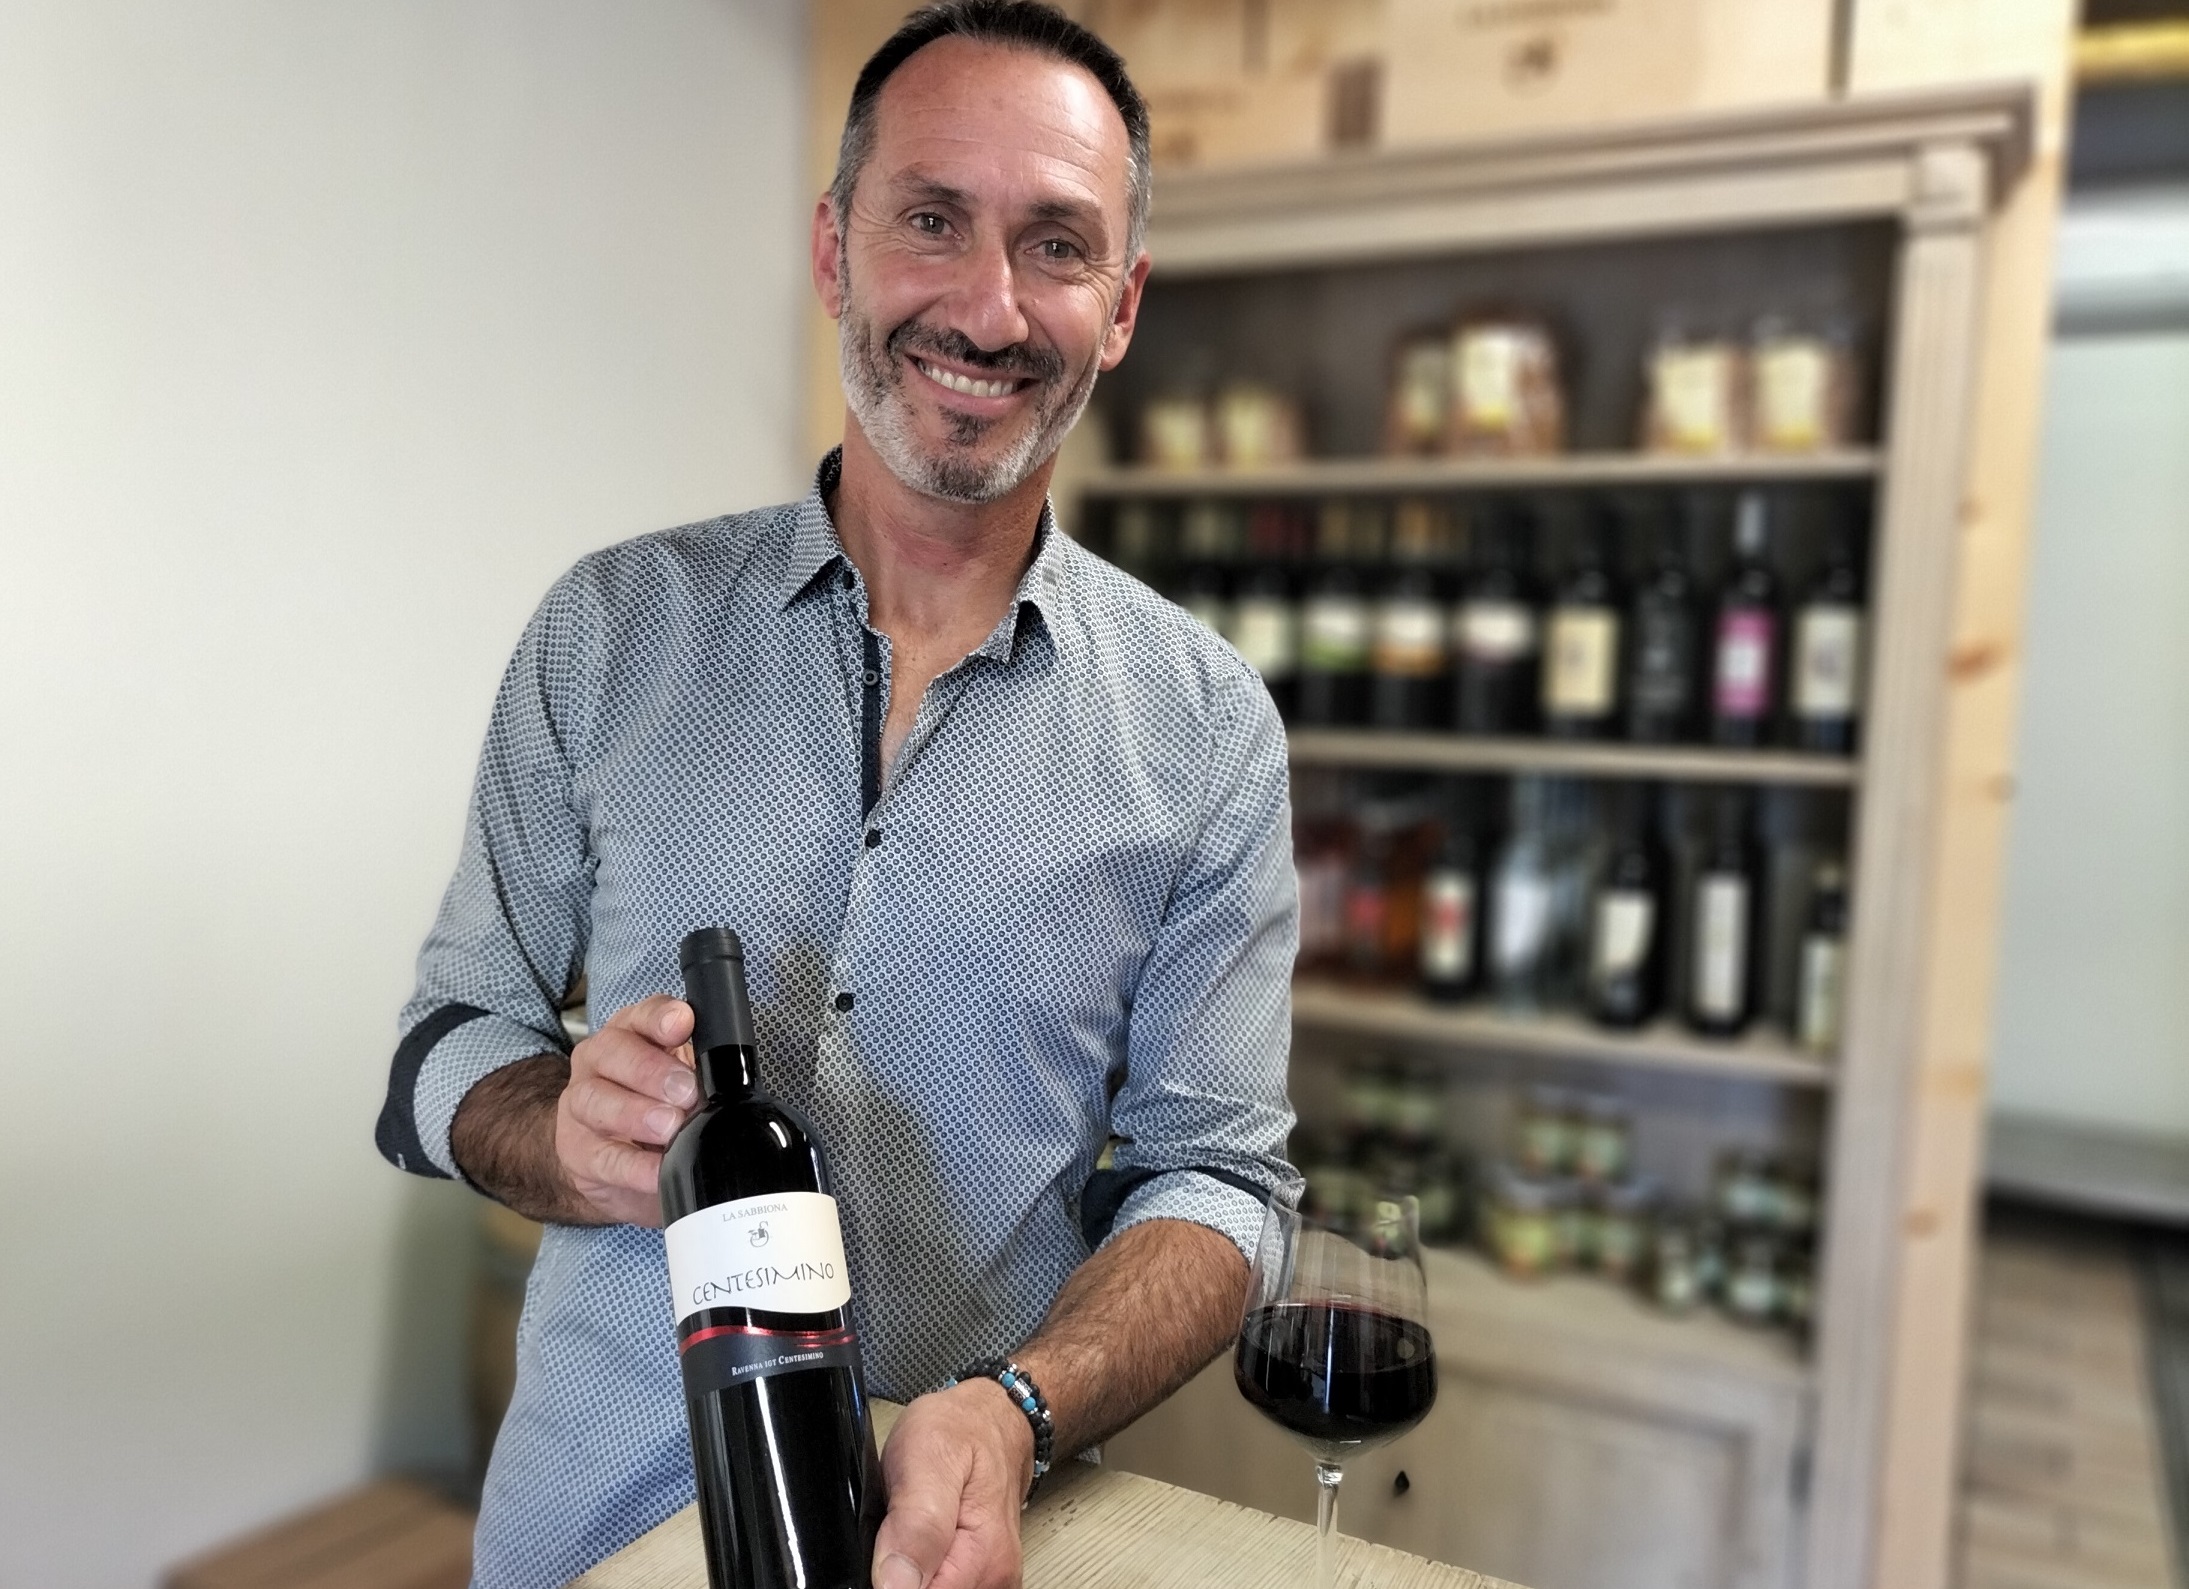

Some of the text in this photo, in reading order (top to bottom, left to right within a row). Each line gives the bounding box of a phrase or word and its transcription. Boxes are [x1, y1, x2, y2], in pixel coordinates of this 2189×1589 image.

[722, 1203, 788, 1222] LA SABBIONA
[692, 1262, 835, 1306] CENTESIMINO
[731, 1363, 763, 1376] RAVENNA
[778, 1351, 824, 1365] CENTESIMINO
